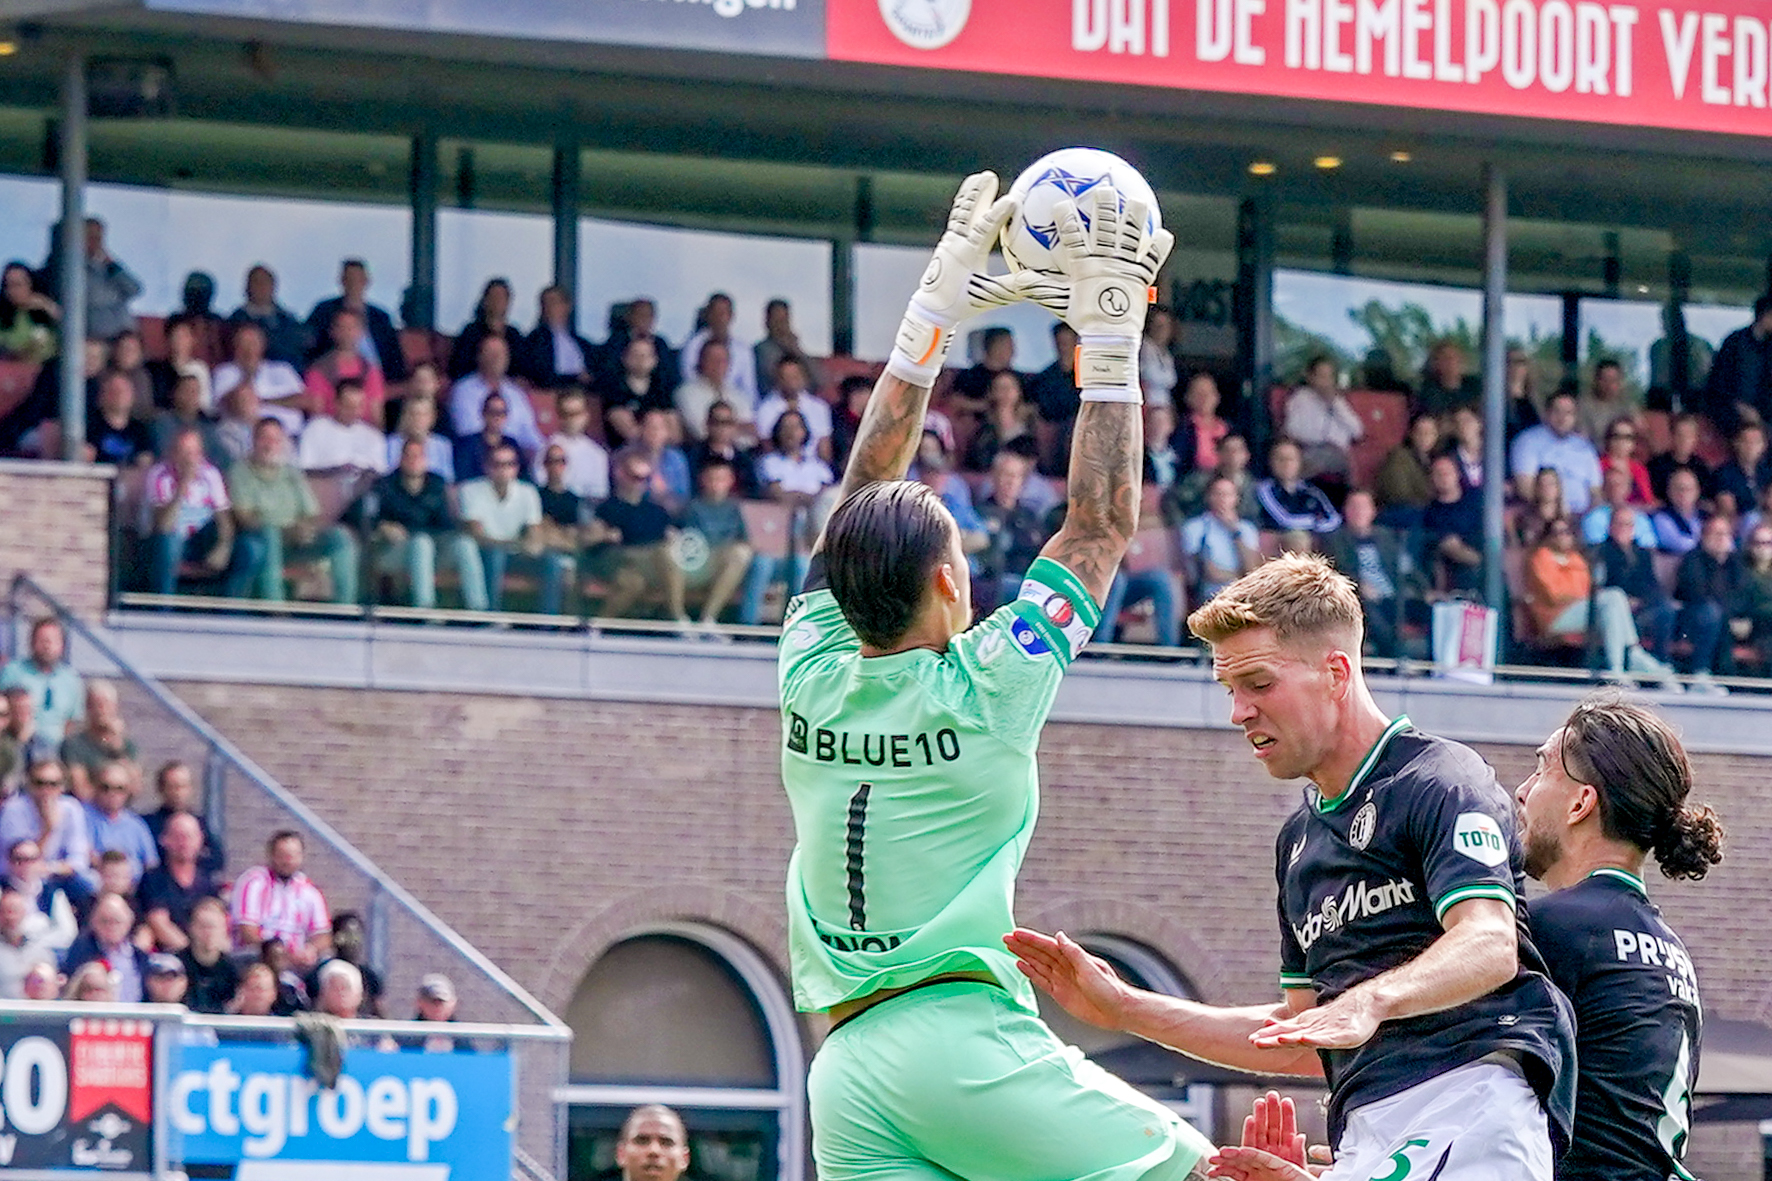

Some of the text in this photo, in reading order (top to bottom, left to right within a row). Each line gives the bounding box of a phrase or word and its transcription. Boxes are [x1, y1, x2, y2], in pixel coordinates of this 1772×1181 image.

[1196, 0, 1267, 66] DE
[1284, 0, 1639, 98] HEMELPOORT
[816, 727, 961, 768] BLUE10
[1458, 826, 1501, 851] TOTO
[170, 1058, 459, 1162] ctgroep
